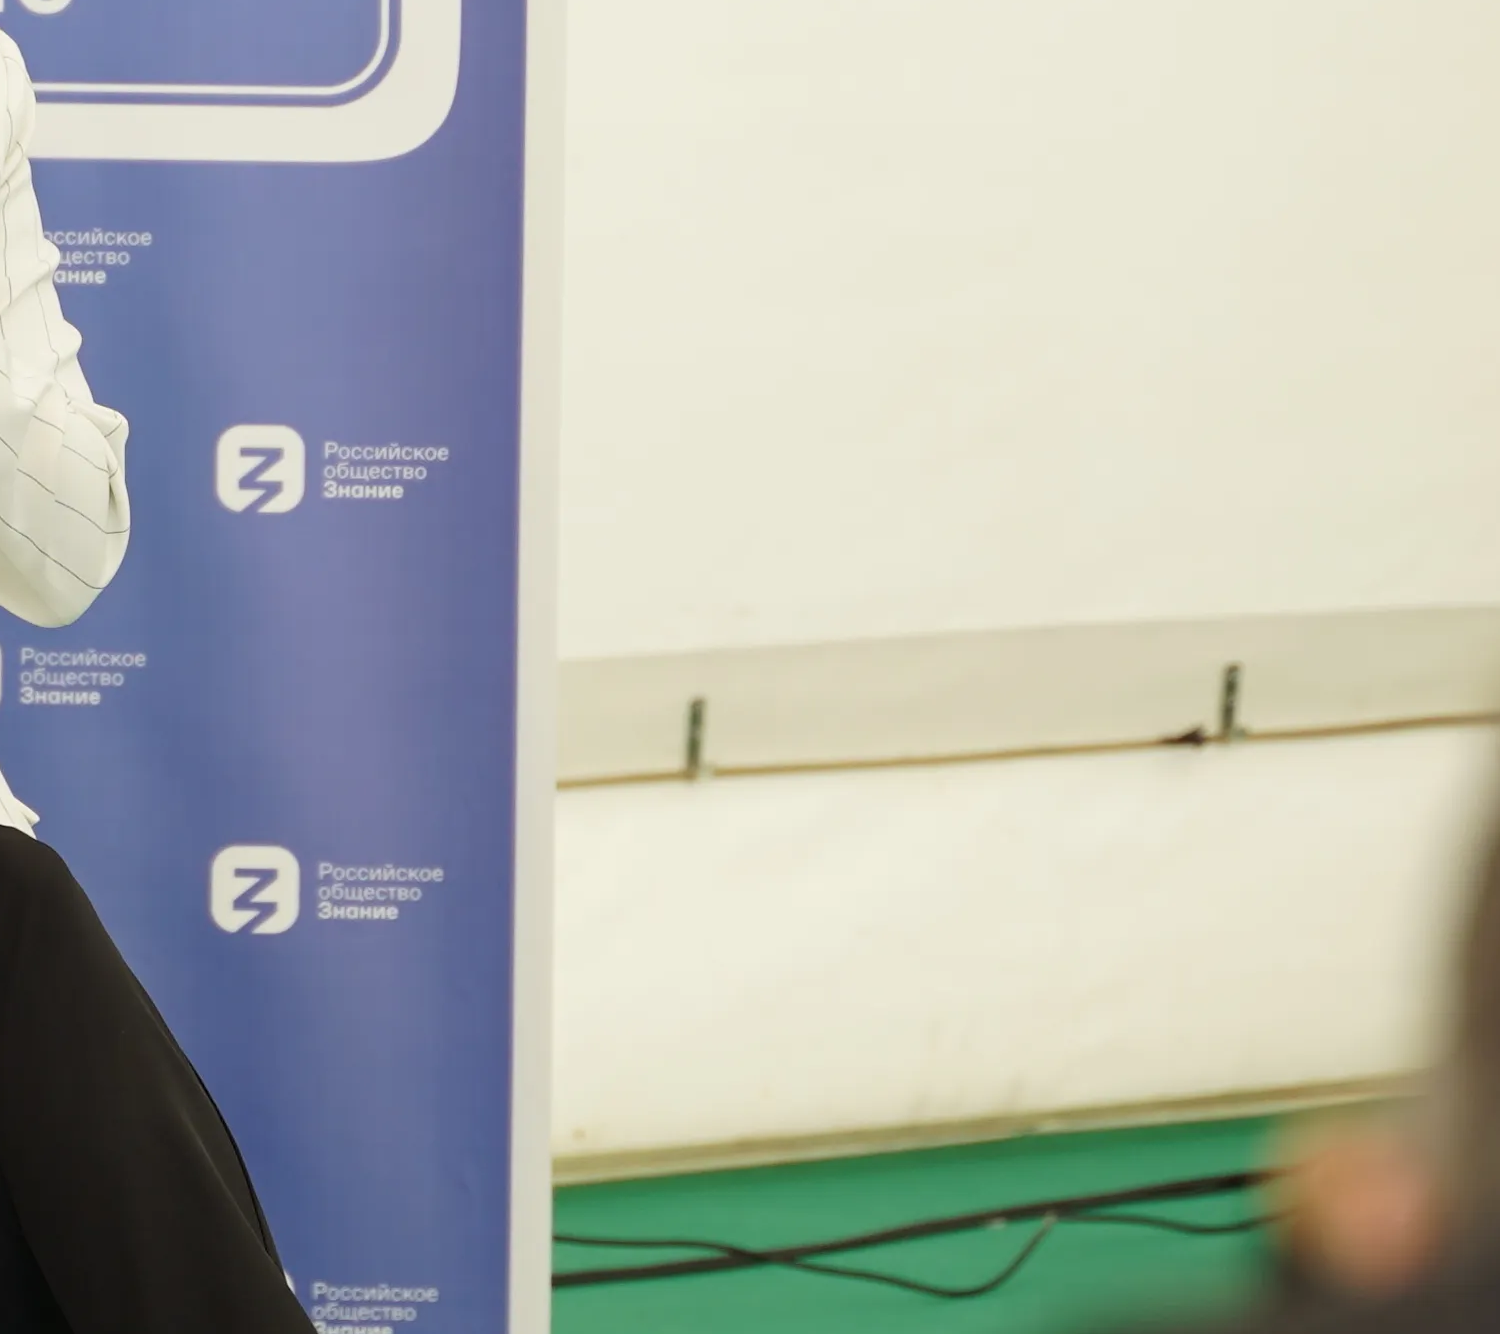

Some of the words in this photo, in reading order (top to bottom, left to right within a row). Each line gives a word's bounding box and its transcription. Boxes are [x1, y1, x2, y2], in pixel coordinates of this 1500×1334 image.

[53, 269, 107, 284] ание
[323, 440, 449, 460] Российское
[322, 461, 428, 481] общество
[322, 479, 405, 498] Знание
[20, 646, 147, 666] Российское
[20, 667, 125, 687] общество
[19, 685, 102, 704] Знание
[318, 861, 444, 881] Российское
[317, 882, 422, 902] общество
[317, 900, 399, 919] Знание
[312, 1281, 440, 1303] Российское
[311, 1301, 418, 1322] общество
